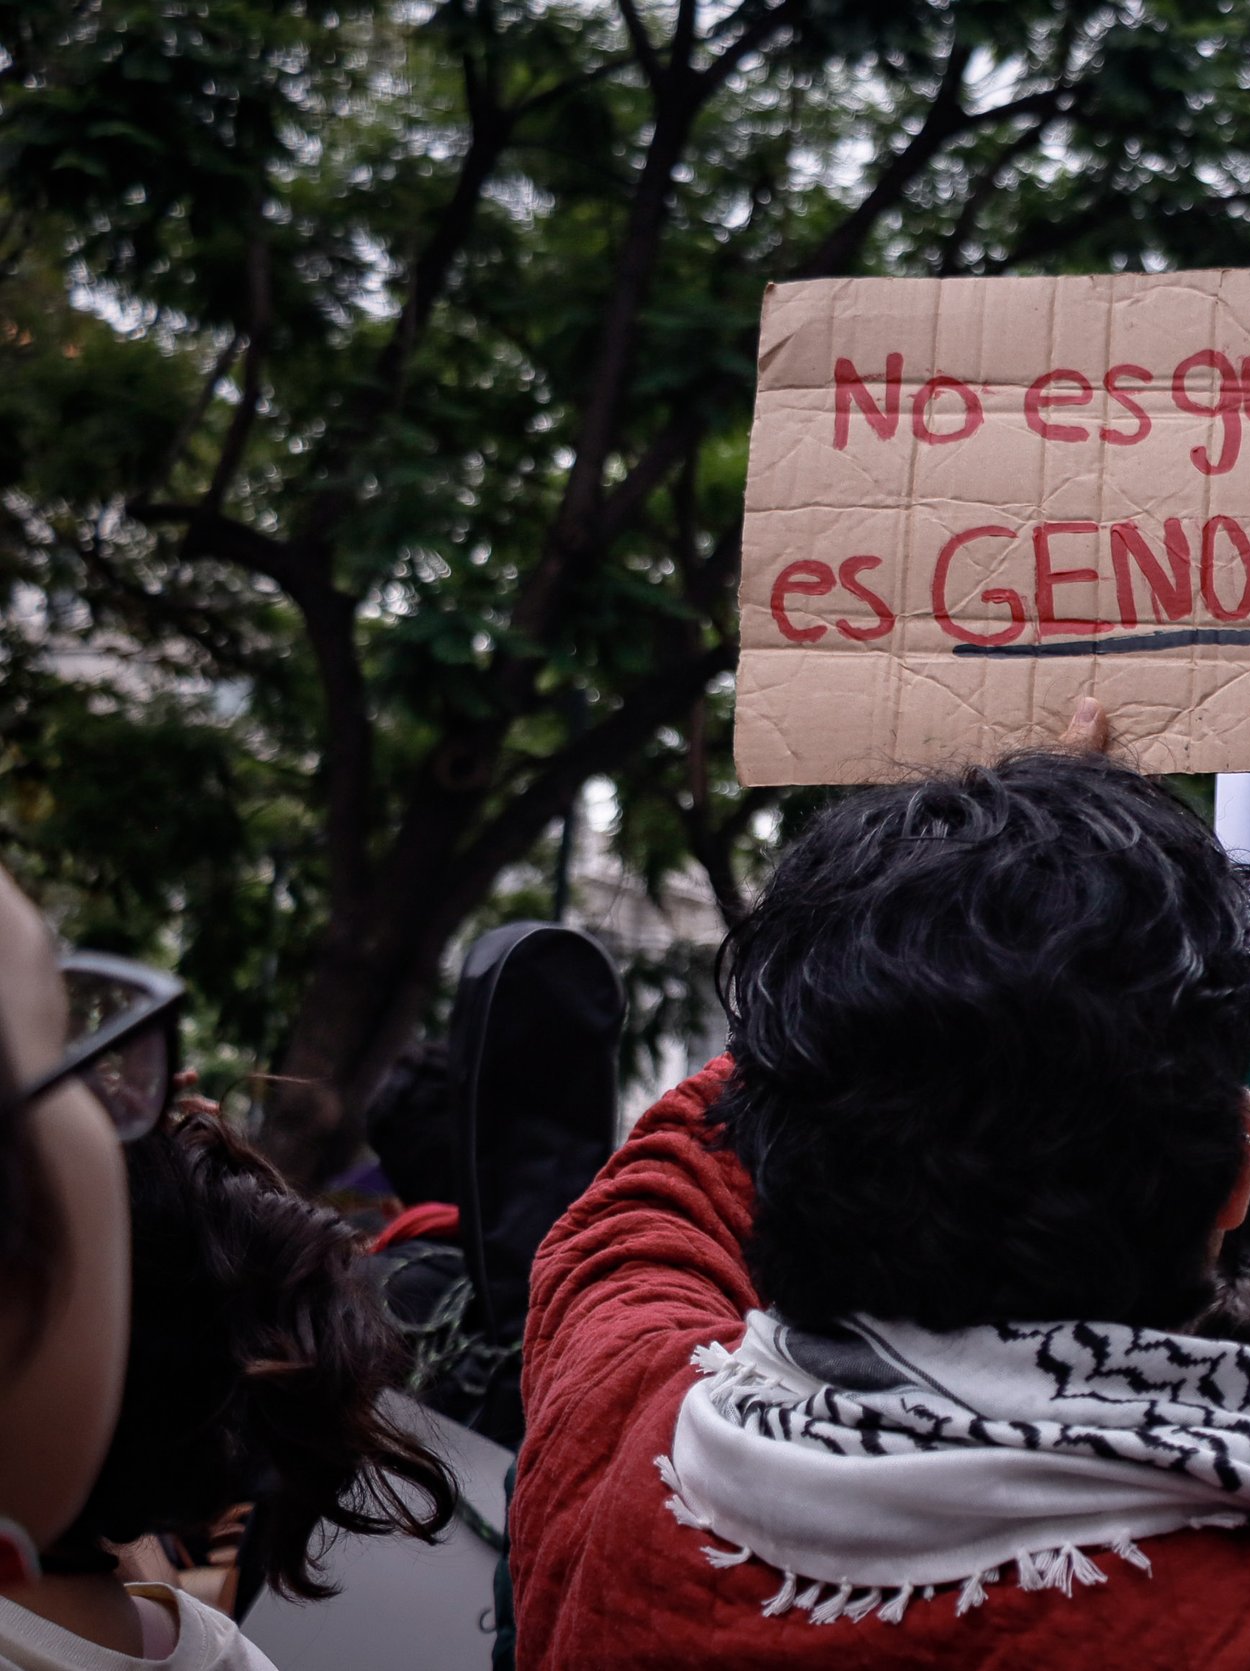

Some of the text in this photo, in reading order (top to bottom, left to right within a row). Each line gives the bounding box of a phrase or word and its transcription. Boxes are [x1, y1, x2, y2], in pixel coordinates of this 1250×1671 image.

[834, 352, 985, 451] No
[1023, 364, 1153, 446] es
[769, 555, 897, 644] es
